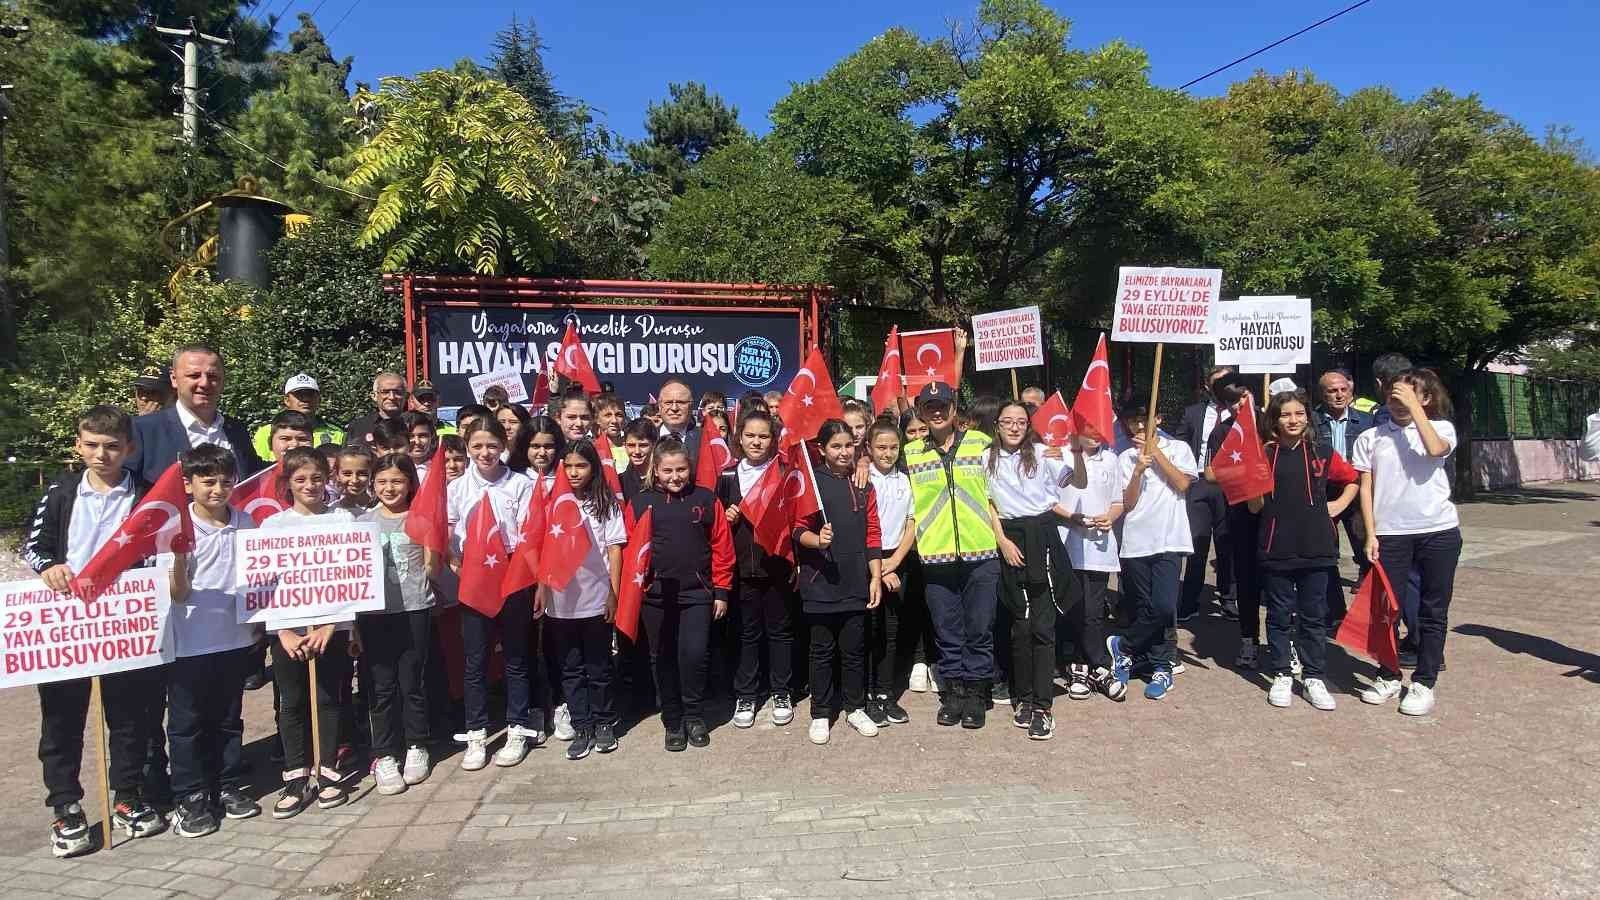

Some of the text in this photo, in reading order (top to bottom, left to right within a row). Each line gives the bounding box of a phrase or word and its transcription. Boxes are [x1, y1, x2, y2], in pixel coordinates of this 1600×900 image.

[1123, 289, 1141, 301] 29
[1192, 291, 1210, 302] DE
[1121, 303, 1144, 315] YAYA
[634, 313, 704, 338] Duruşu
[979, 330, 989, 339] 29
[1023, 323, 1036, 334] DE
[1240, 322, 1282, 335] HAYATA
[740, 346, 759, 356] HER
[1219, 336, 1305, 352] SAYGI DURUŞU
[439, 341, 735, 377] HAYATA SYGI DURUŞU
[739, 354, 771, 368] DAHA
[298, 532, 372, 548] BAYRAKLARLA
[246, 555, 271, 570] 29
[346, 547, 372, 562] DE
[246, 571, 279, 588] YAYA
[4, 611, 33, 629] 29
[125, 596, 158, 615] DE
[3, 628, 45, 649] YAYA
